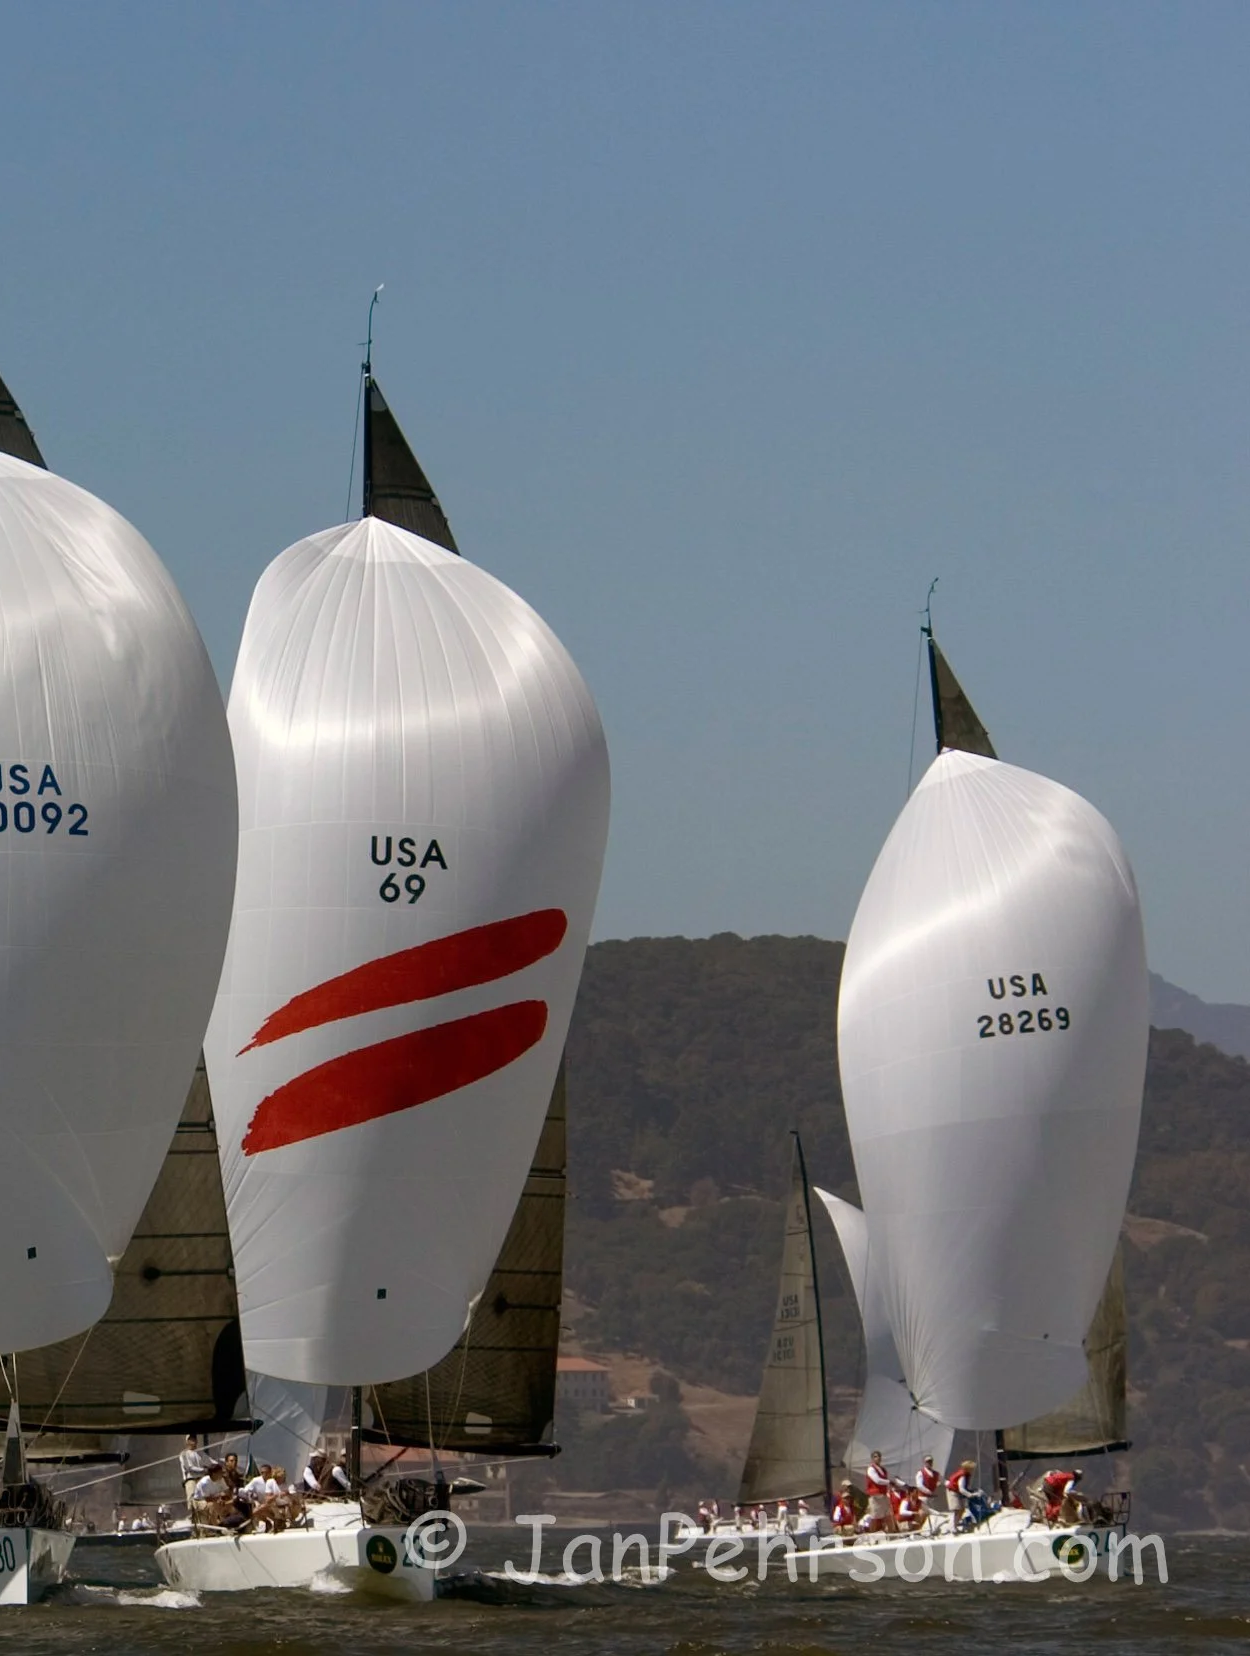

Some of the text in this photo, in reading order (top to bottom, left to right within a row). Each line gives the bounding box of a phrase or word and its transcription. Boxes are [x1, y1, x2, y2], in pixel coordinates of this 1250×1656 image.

[371, 836, 448, 870] USA
[379, 872, 426, 904] 69
[987, 973, 1048, 1000] USA
[977, 1006, 1070, 1039] 28269
